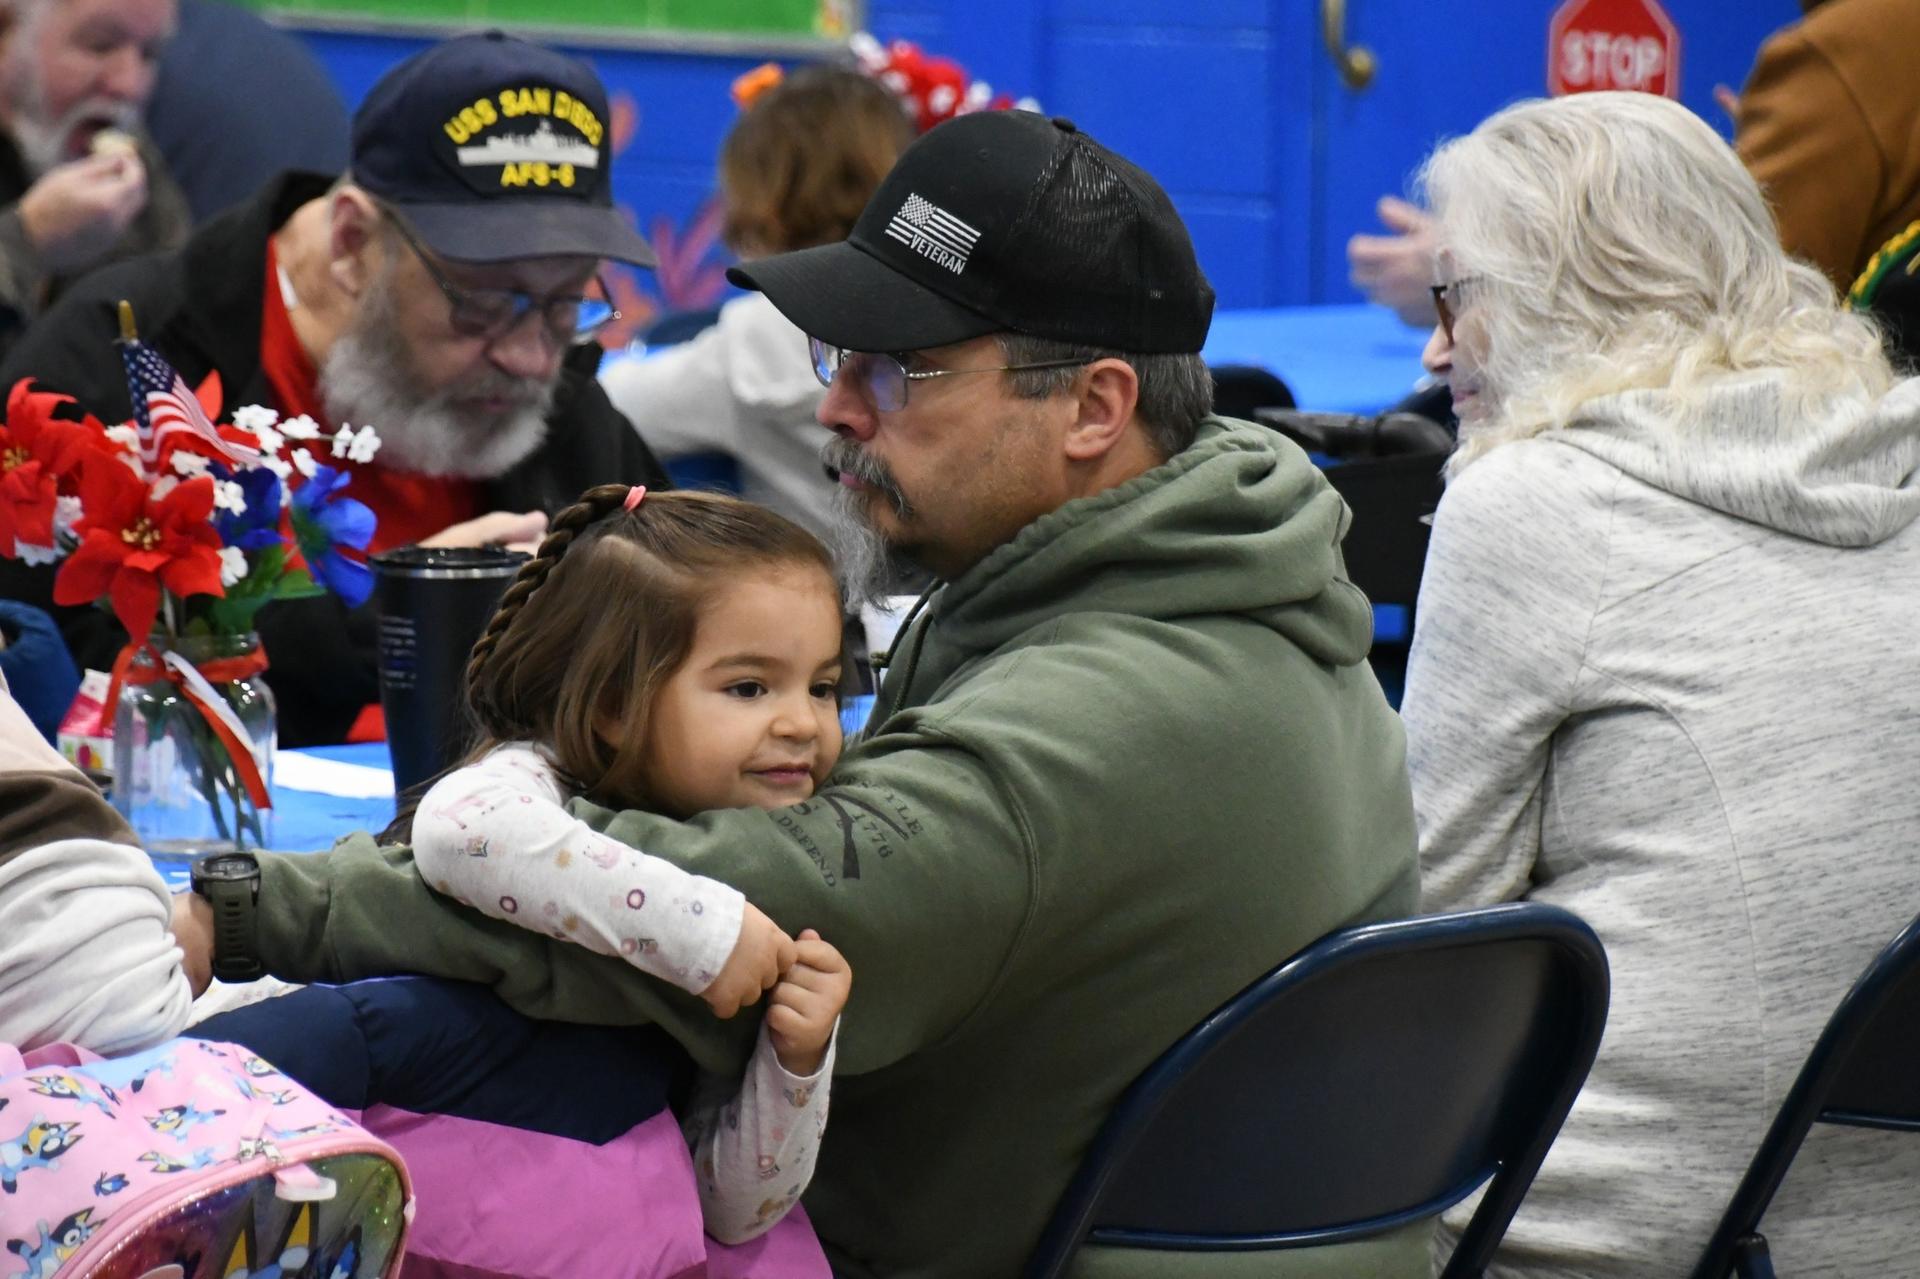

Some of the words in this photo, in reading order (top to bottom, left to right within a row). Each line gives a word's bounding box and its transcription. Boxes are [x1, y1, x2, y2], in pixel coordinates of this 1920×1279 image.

[1561, 29, 1665, 89] STOP
[443, 98, 498, 144] USS
[499, 87, 551, 118] SAN
[909, 233, 967, 275] VETERAN
[777, 815, 837, 888] DEFEND
[851, 812, 893, 859] 1776
